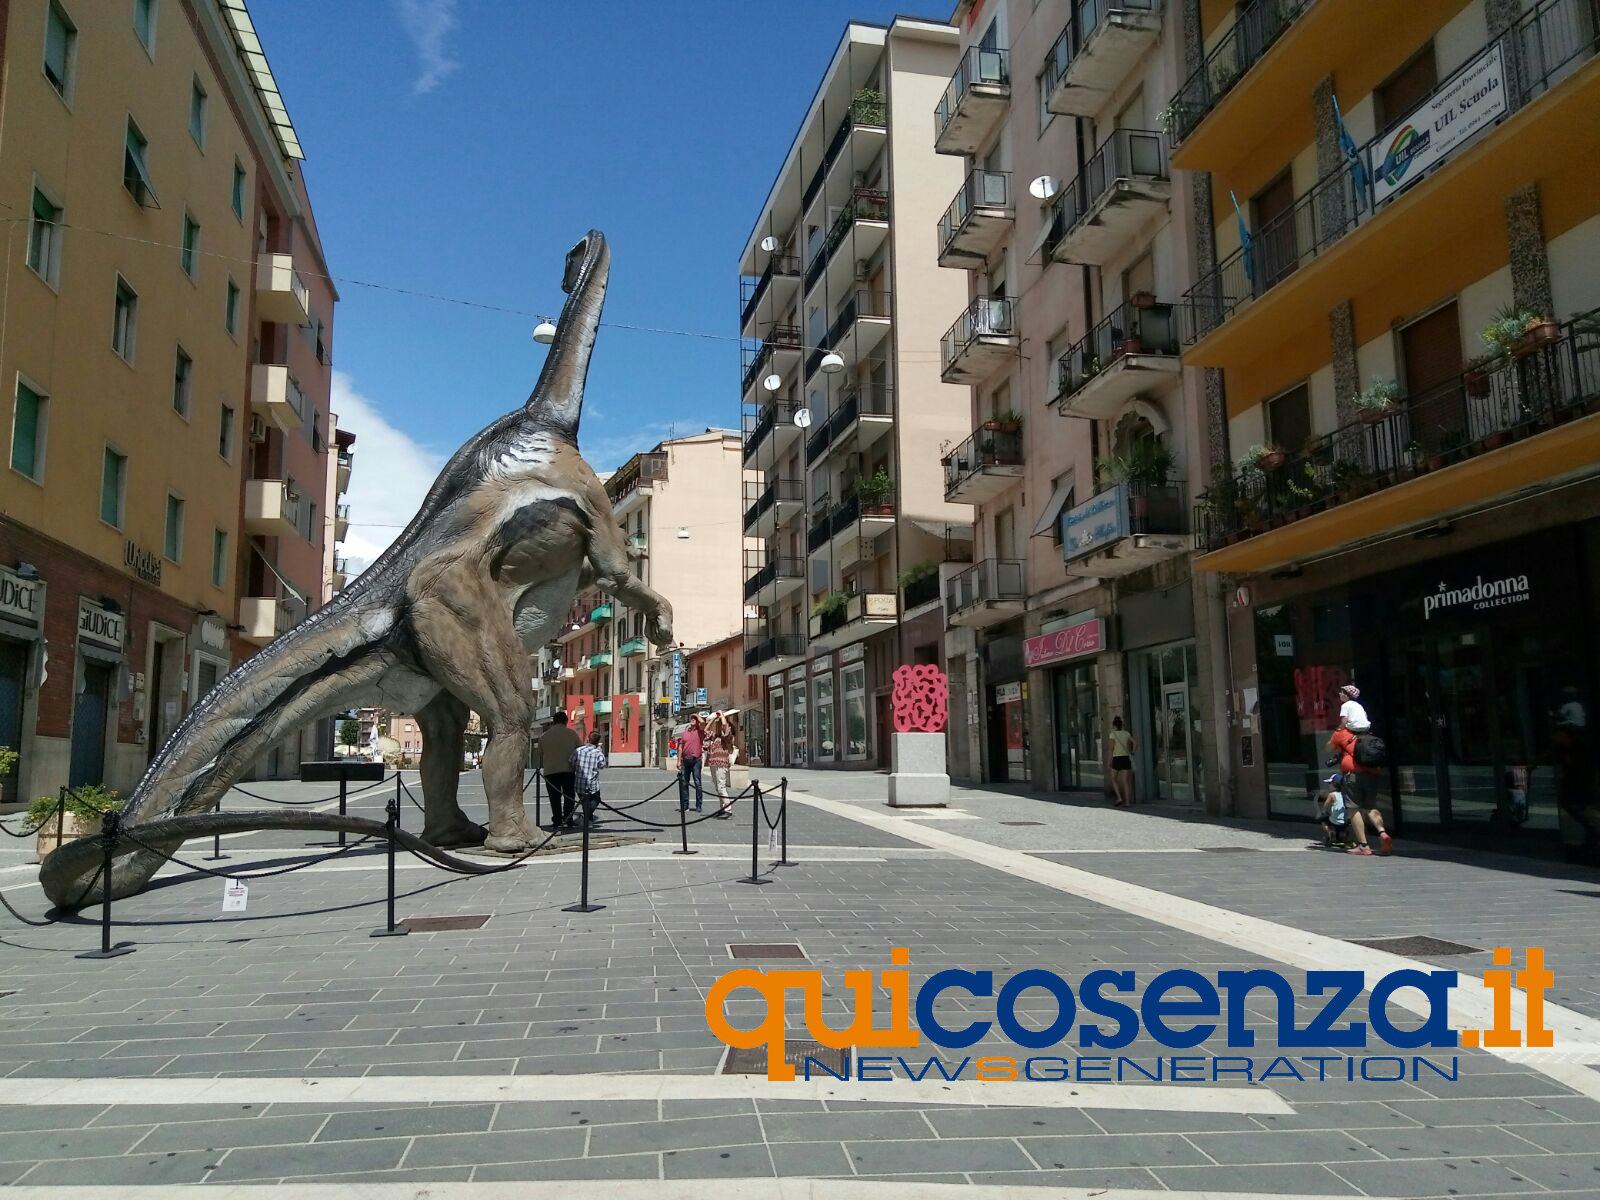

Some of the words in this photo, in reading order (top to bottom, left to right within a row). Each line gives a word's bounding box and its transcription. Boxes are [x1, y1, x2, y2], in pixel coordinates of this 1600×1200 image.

[1462, 54, 1498, 86] Provinciale
[1434, 109, 1458, 133] UIL
[1459, 77, 1499, 114] Scuola
[1395, 146, 1410, 165] UIL
[1424, 575, 1529, 620] primadonna
[1473, 593, 1530, 610] COLLECTION
[673, 653, 681, 712] TABACCHI
